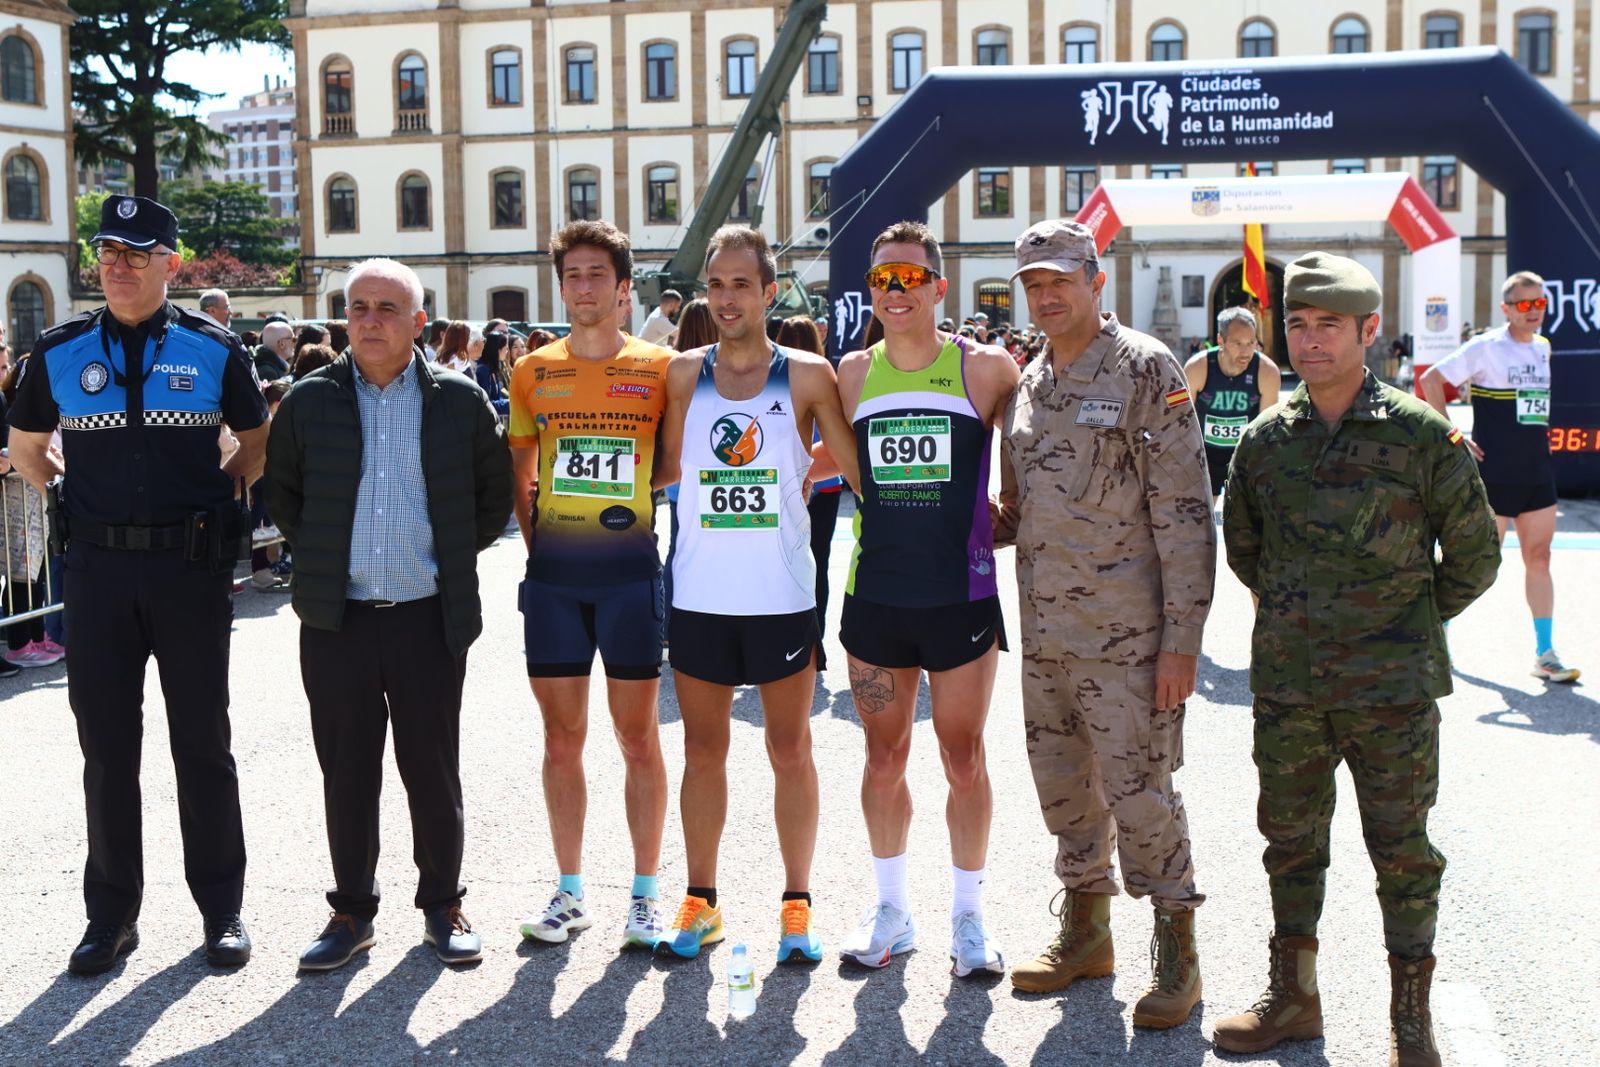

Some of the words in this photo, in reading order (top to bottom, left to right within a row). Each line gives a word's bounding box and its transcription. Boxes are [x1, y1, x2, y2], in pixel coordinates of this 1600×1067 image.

[1180, 76, 1262, 92] Ciudades
[1180, 93, 1280, 112] Patrimonio
[1180, 116, 1203, 133] de
[1208, 115, 1225, 132] la
[1231, 111, 1334, 131] Humanidad
[1182, 136, 1226, 146] ESPAÑA
[1235, 135, 1280, 145] UNESCO
[1236, 203, 1293, 211] Salamanca
[152, 364, 199, 376] POLICÍA
[1210, 390, 1249, 411] AVS
[1524, 399, 1547, 413] 754
[547, 411, 597, 421] ESCUELA
[600, 412, 653, 423] TRIATLÓN
[558, 422, 637, 431] SALMANTINA
[871, 420, 888, 434] XIV
[889, 425, 927, 434] CARRERA
[1211, 425, 1241, 438] 635
[560, 439, 578, 450] XIV
[880, 435, 937, 464] 690
[566, 454, 619, 480] 811
[710, 486, 766, 513] 663
[879, 491, 910, 500] ROBERTO
[912, 490, 941, 500] RAMOS
